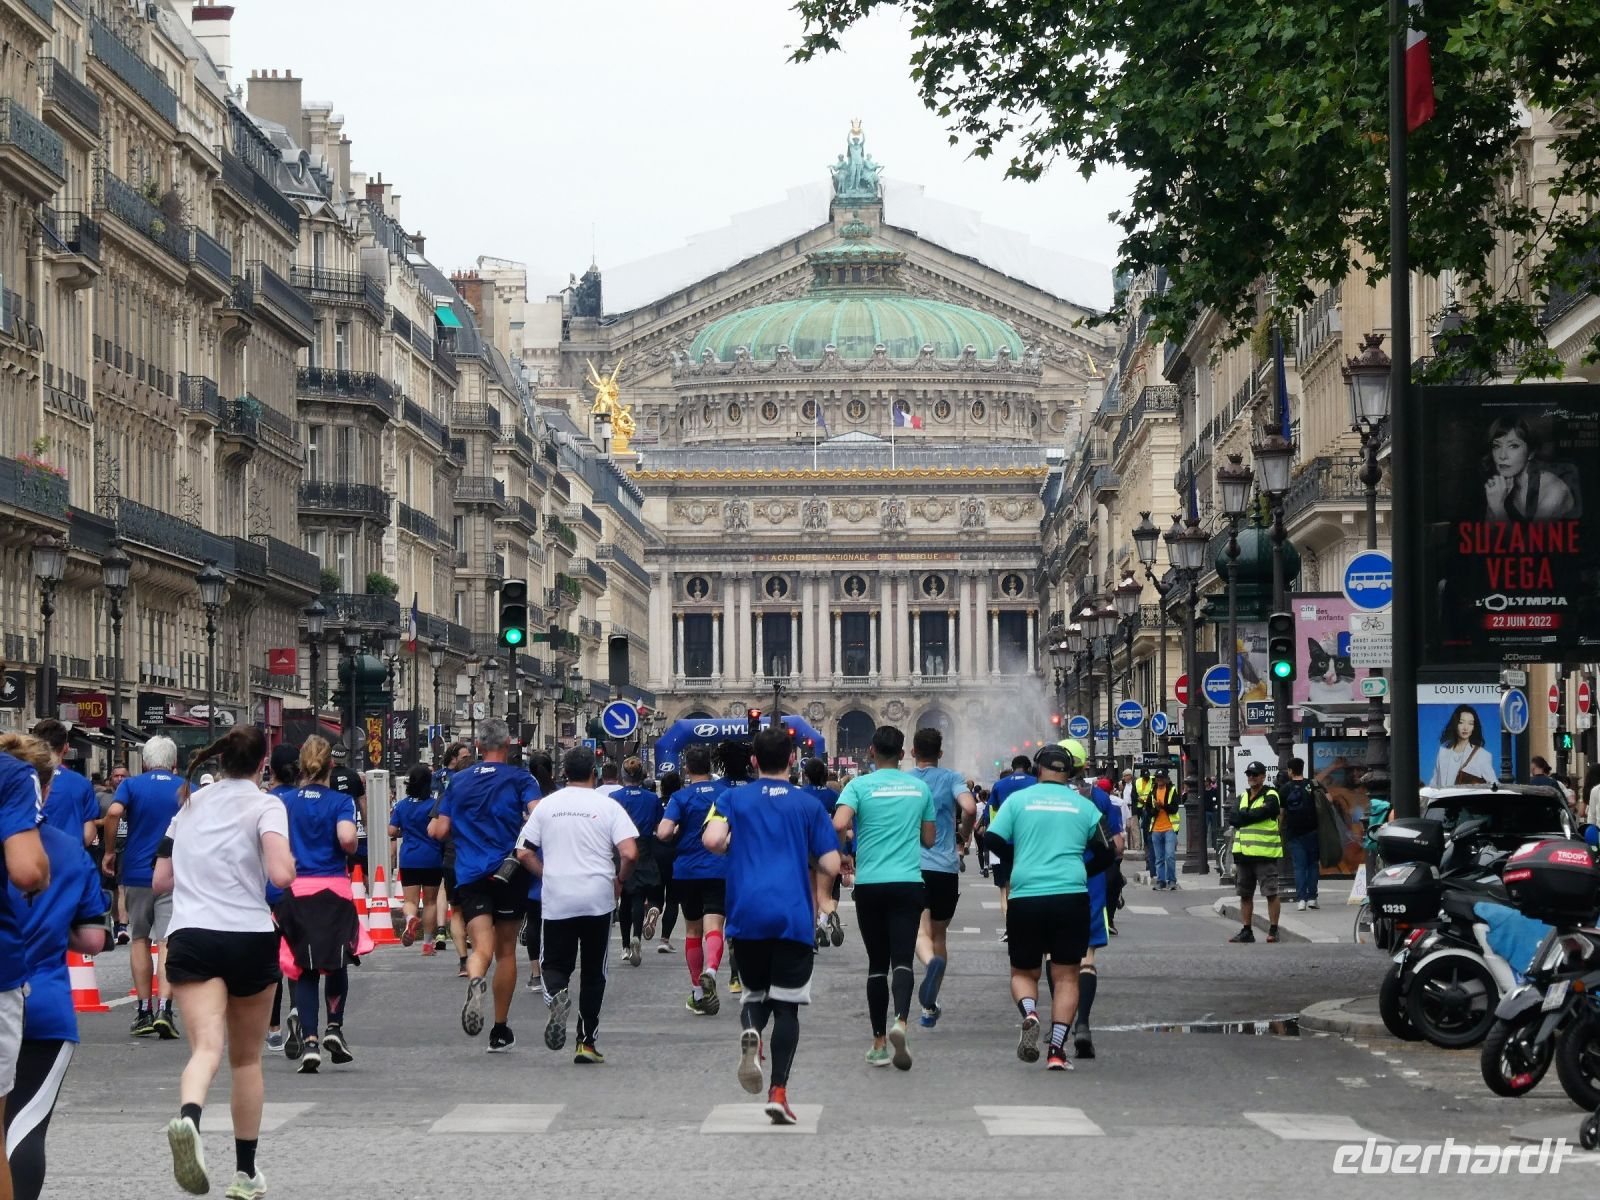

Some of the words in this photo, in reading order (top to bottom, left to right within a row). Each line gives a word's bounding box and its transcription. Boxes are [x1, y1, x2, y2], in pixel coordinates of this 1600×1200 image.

[1459, 521, 1580, 554] SUZANNE
[825, 553, 869, 561] NATIONALE
[877, 553, 889, 561] DE
[896, 553, 939, 561] MUSIQUE
[1487, 557, 1553, 589] VEGA
[1475, 593, 1568, 611] L'OLYMPIA
[1493, 616, 1504, 627] 22
[1506, 616, 1526, 627] JUIN
[1529, 616, 1552, 627] 2022
[1435, 685, 1464, 694] LOUIS
[1557, 850, 1587, 861] TROOPY
[1382, 904, 1407, 914] 1329
